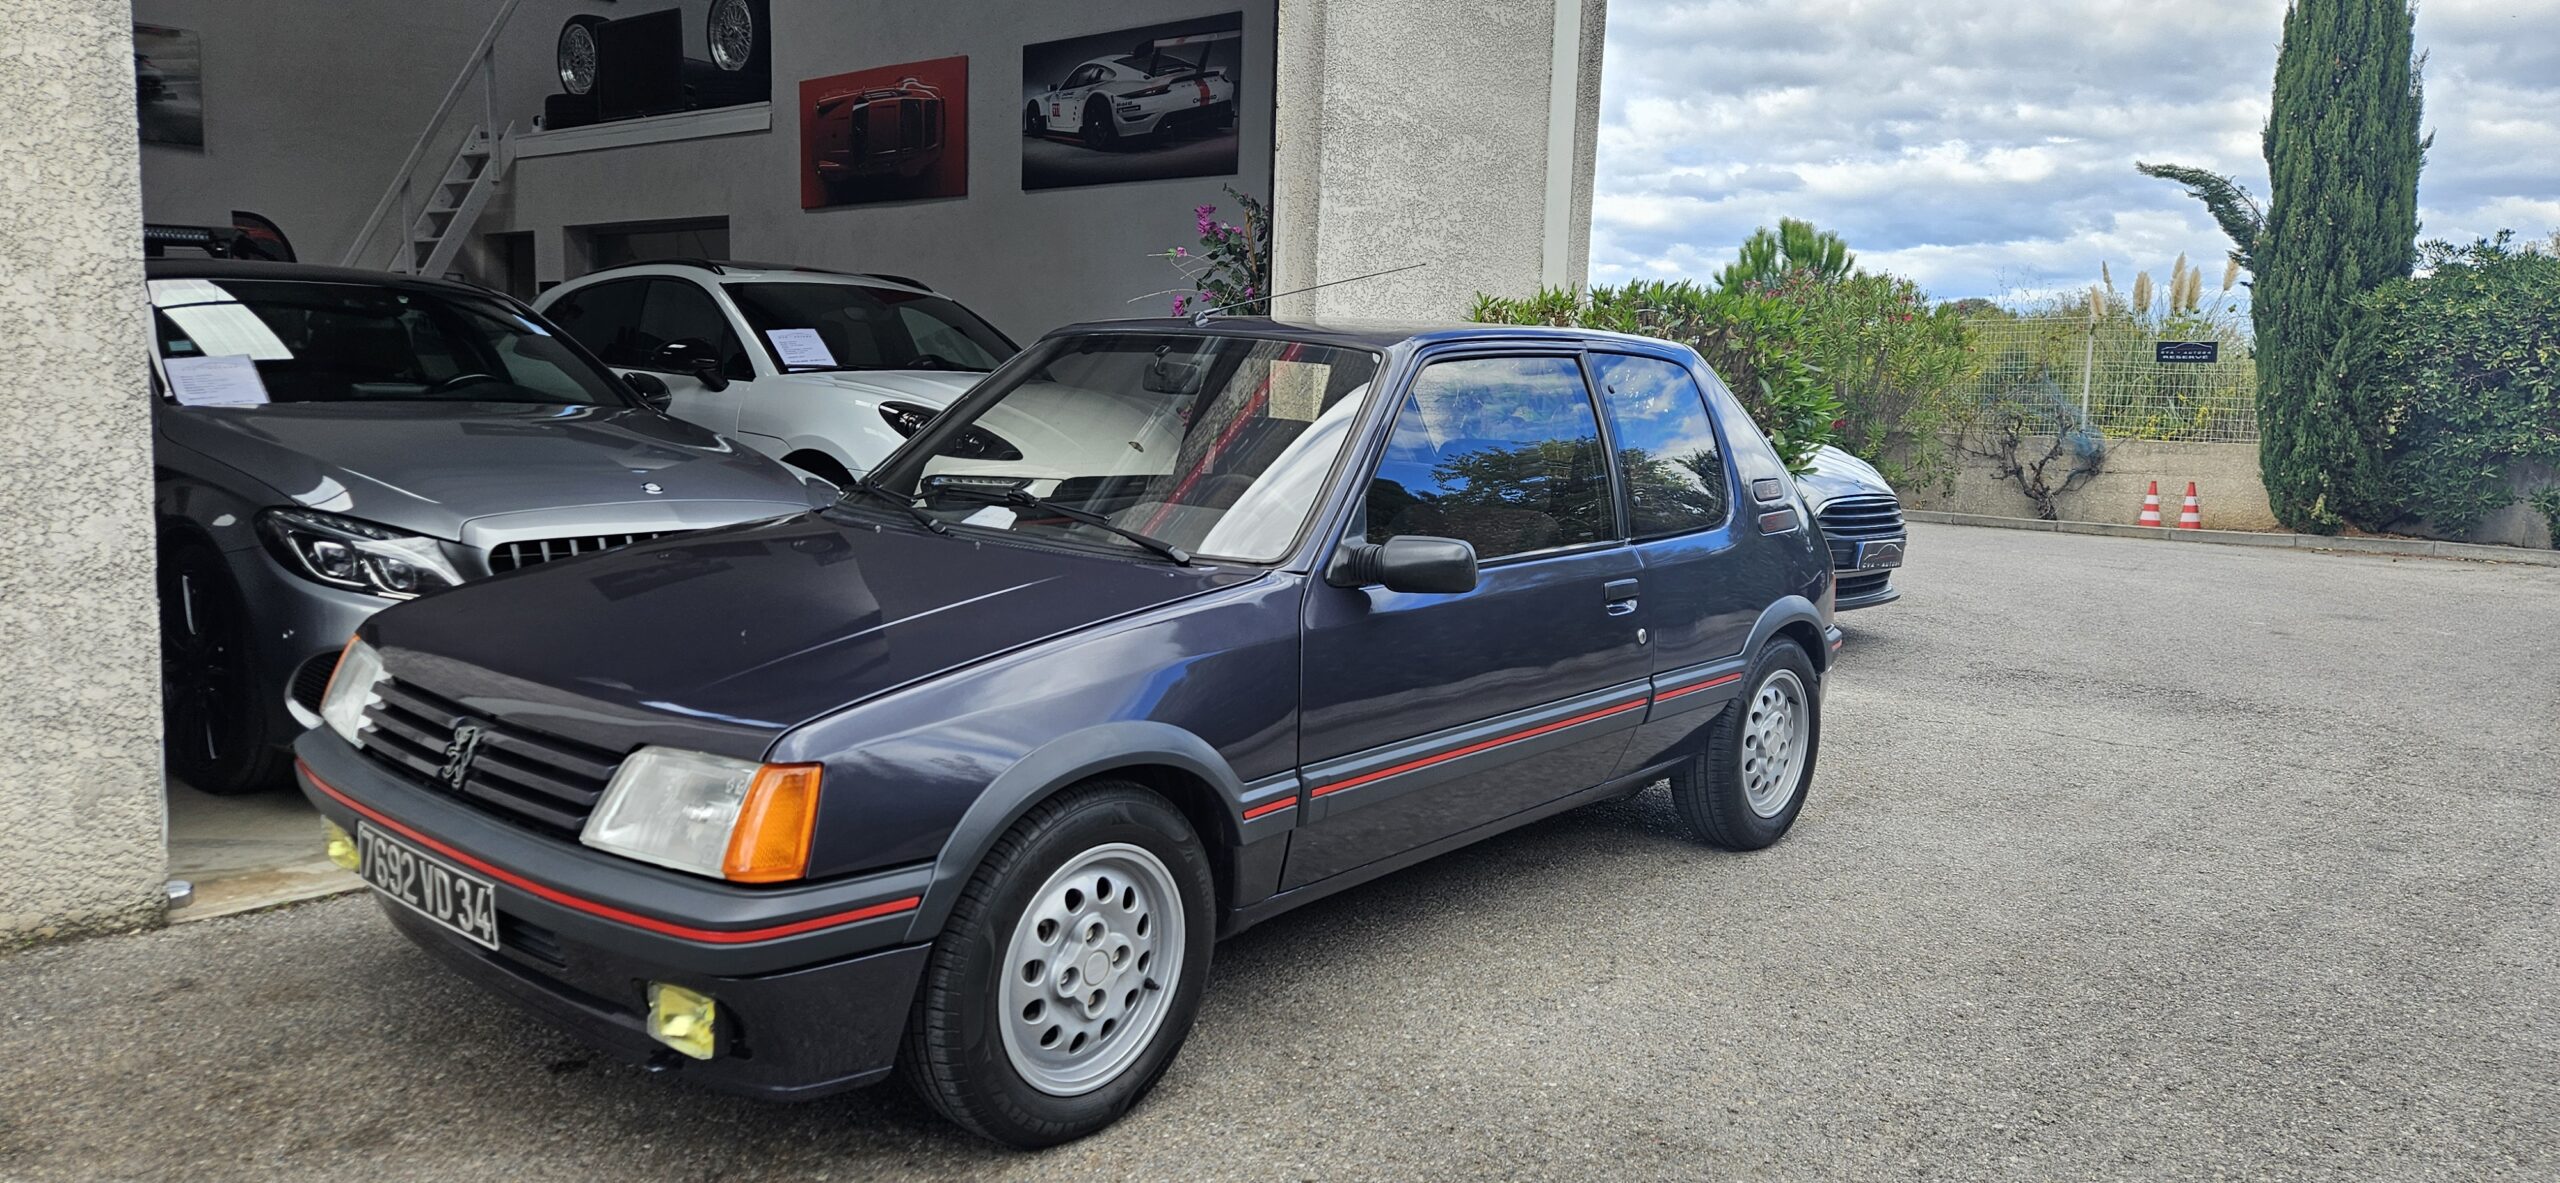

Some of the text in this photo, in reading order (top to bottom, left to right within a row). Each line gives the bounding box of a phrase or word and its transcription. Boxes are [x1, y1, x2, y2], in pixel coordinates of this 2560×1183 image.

[361, 830, 491, 941] 7692 VD 34
